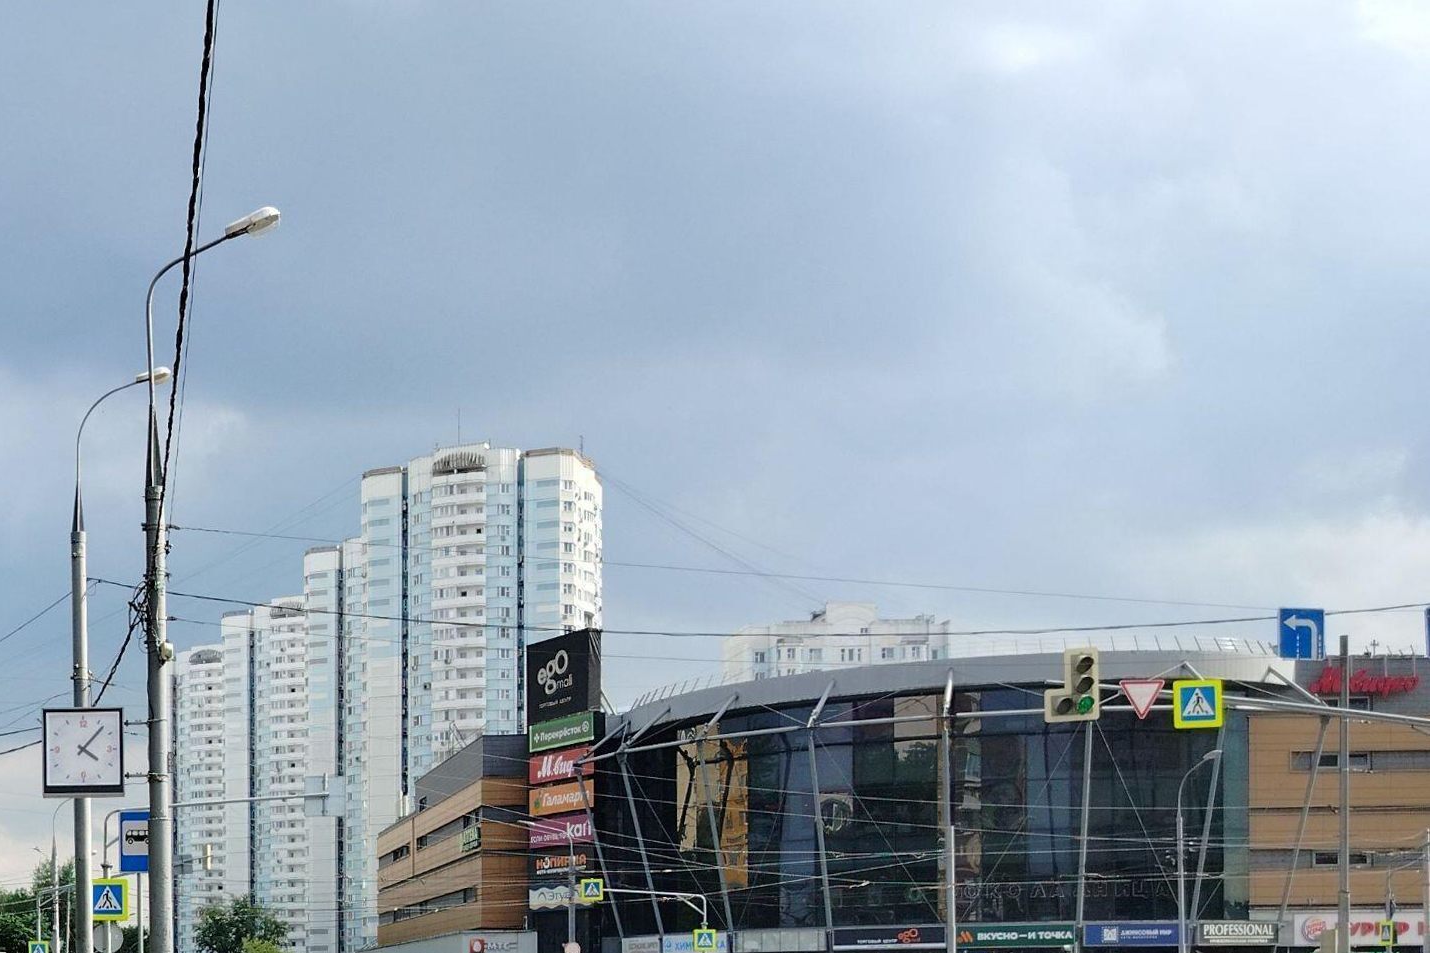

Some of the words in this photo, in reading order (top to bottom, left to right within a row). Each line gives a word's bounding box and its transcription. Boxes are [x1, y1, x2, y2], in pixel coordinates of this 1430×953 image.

[540, 726, 582, 742] Перекрёсток
[1037, 930, 1073, 940] ТОЧКА
[1203, 924, 1275, 936] PROFESSIONAL
